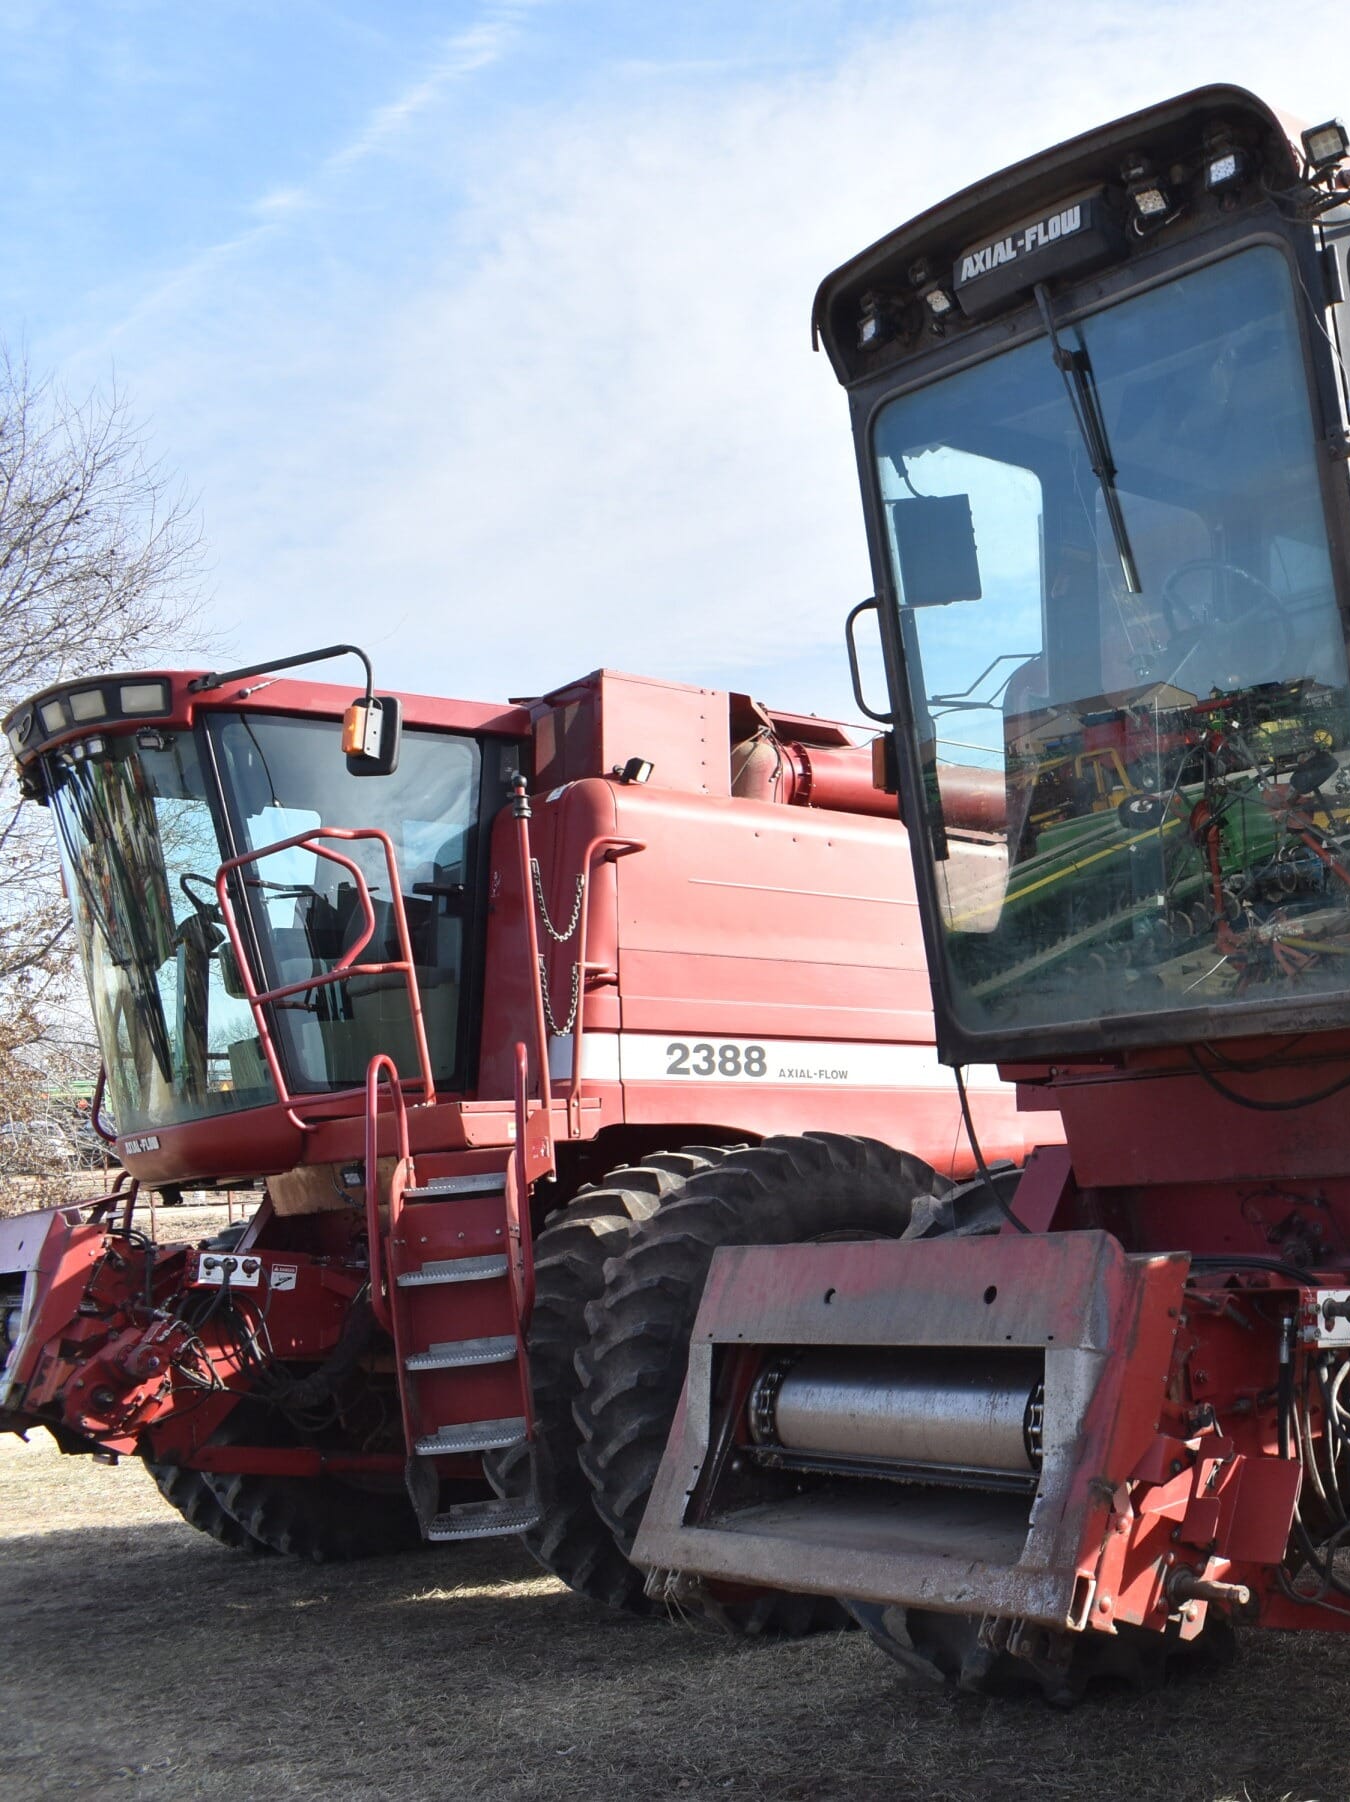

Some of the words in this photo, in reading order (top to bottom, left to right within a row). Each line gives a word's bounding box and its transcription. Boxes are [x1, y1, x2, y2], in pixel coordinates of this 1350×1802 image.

[961, 205, 1081, 282] AXIAL-FLOW
[665, 1042, 768, 1078] 2388
[778, 1068, 849, 1080] AXIAL-FLOW
